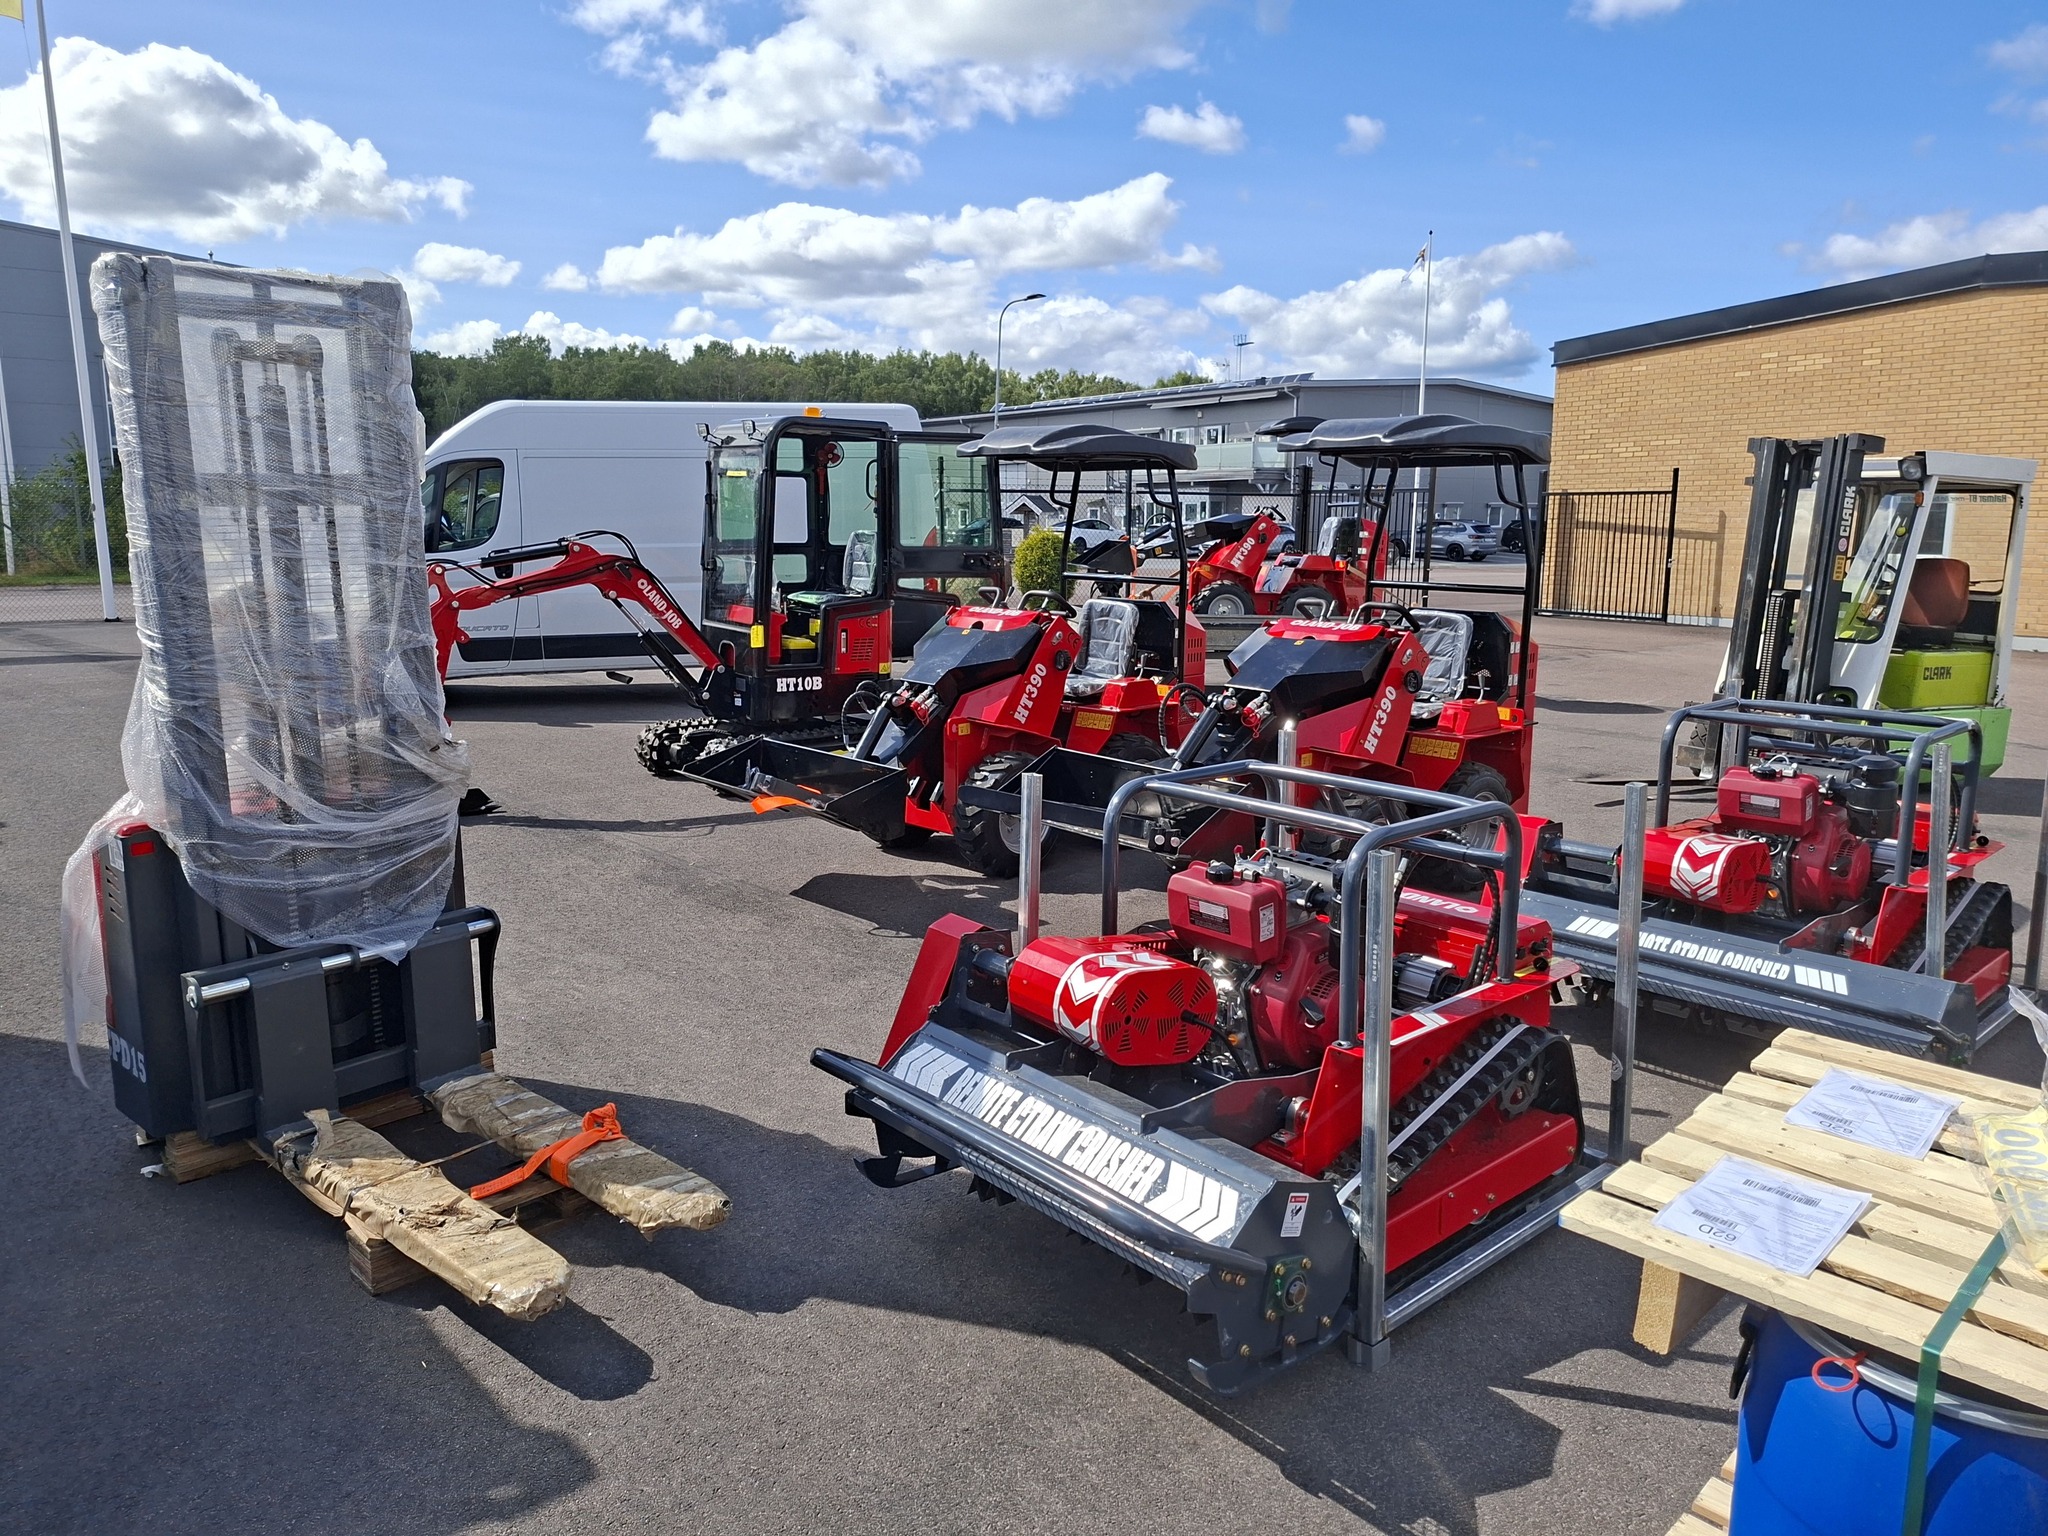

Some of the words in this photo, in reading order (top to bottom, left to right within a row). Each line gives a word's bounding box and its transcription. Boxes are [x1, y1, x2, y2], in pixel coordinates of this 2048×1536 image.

[1839, 486, 1856, 537] CLARK
[1230, 537, 1256, 568] HT390
[776, 676, 823, 693] HT10B
[1923, 666, 1952, 681] CLARK
[1013, 663, 1048, 725] HT390
[1364, 686, 1397, 754] HT390
[1400, 892, 1479, 914] OLAND
[108, 1029, 147, 1084] PD15
[942, 1066, 1024, 1128] REMOTE
[1062, 1127, 1166, 1204] CRUSHER
[1819, 1120, 1854, 1135] 62D
[1699, 1223, 1737, 1242] 62D
